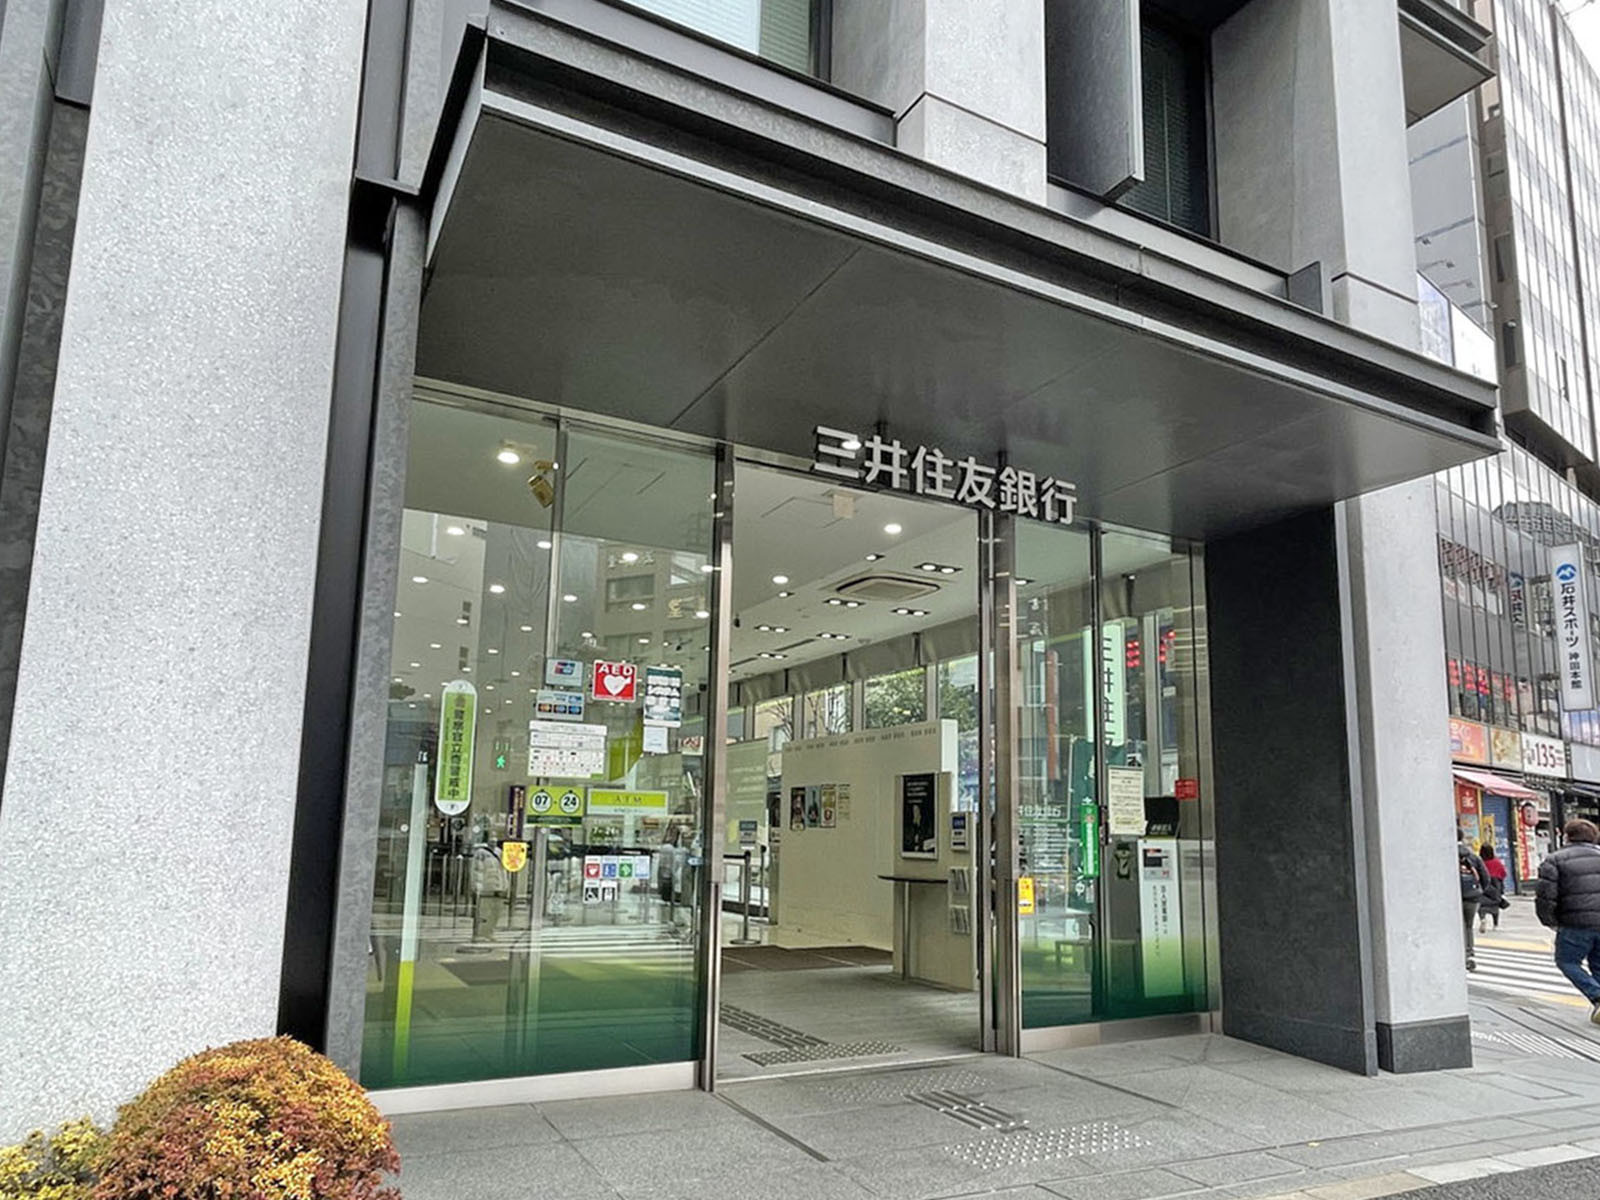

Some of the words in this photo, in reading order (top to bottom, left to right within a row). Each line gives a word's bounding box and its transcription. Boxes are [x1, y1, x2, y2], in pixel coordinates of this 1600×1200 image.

[814, 424, 1077, 525] 三井住友銀行
[1560, 583, 1579, 648] 石井スポーツ
[598, 663, 633, 677] AED
[1535, 743, 1556, 768] 135
[535, 795, 548, 805] 07
[563, 796, 577, 806] 24
